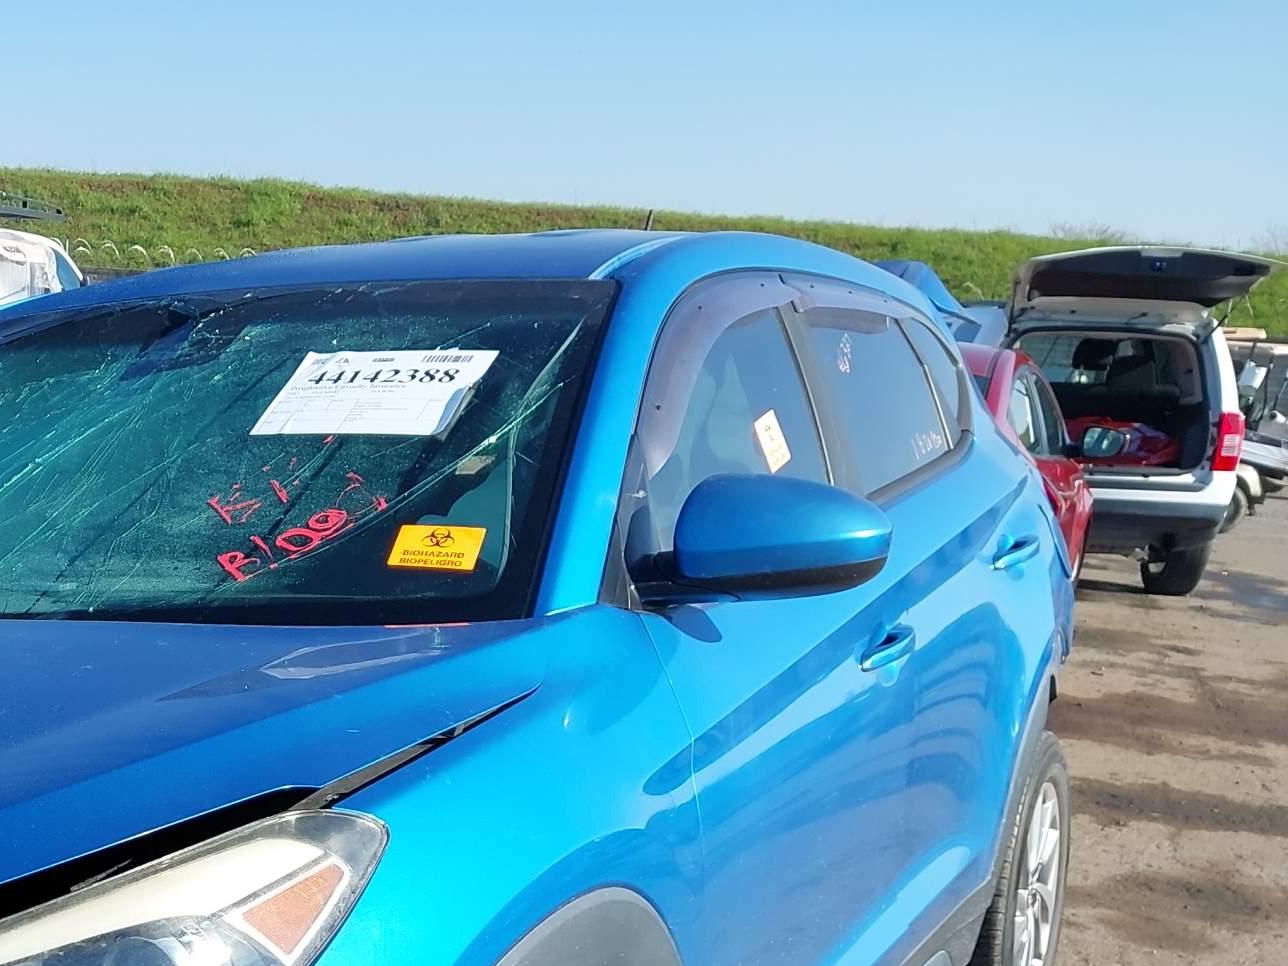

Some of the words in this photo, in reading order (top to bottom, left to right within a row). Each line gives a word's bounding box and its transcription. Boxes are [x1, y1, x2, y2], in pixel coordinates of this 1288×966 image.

[308, 368, 460, 385] 44142388
[402, 549, 465, 559] BIOHAZARD
[398, 557, 463, 567] BIOPELIGRO
